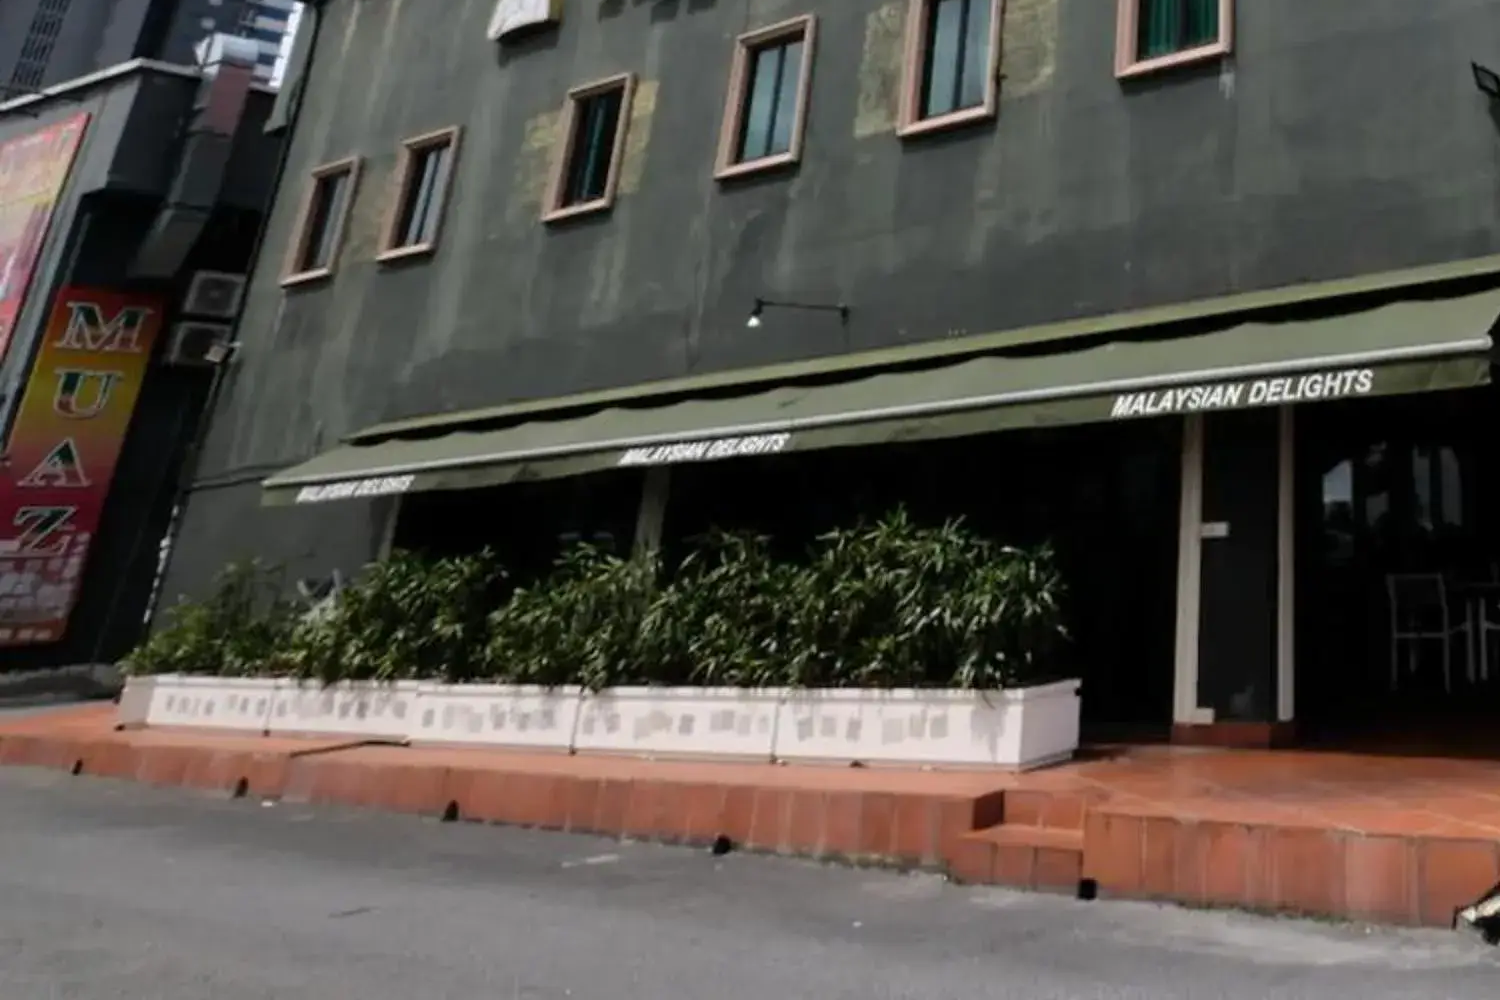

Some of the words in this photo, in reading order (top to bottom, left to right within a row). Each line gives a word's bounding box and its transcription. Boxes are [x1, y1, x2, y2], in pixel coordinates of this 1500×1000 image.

[13, 301, 155, 553] MUAZ
[1111, 383, 1246, 419] MALAYSIAN
[1247, 367, 1374, 405] DELIGHTS
